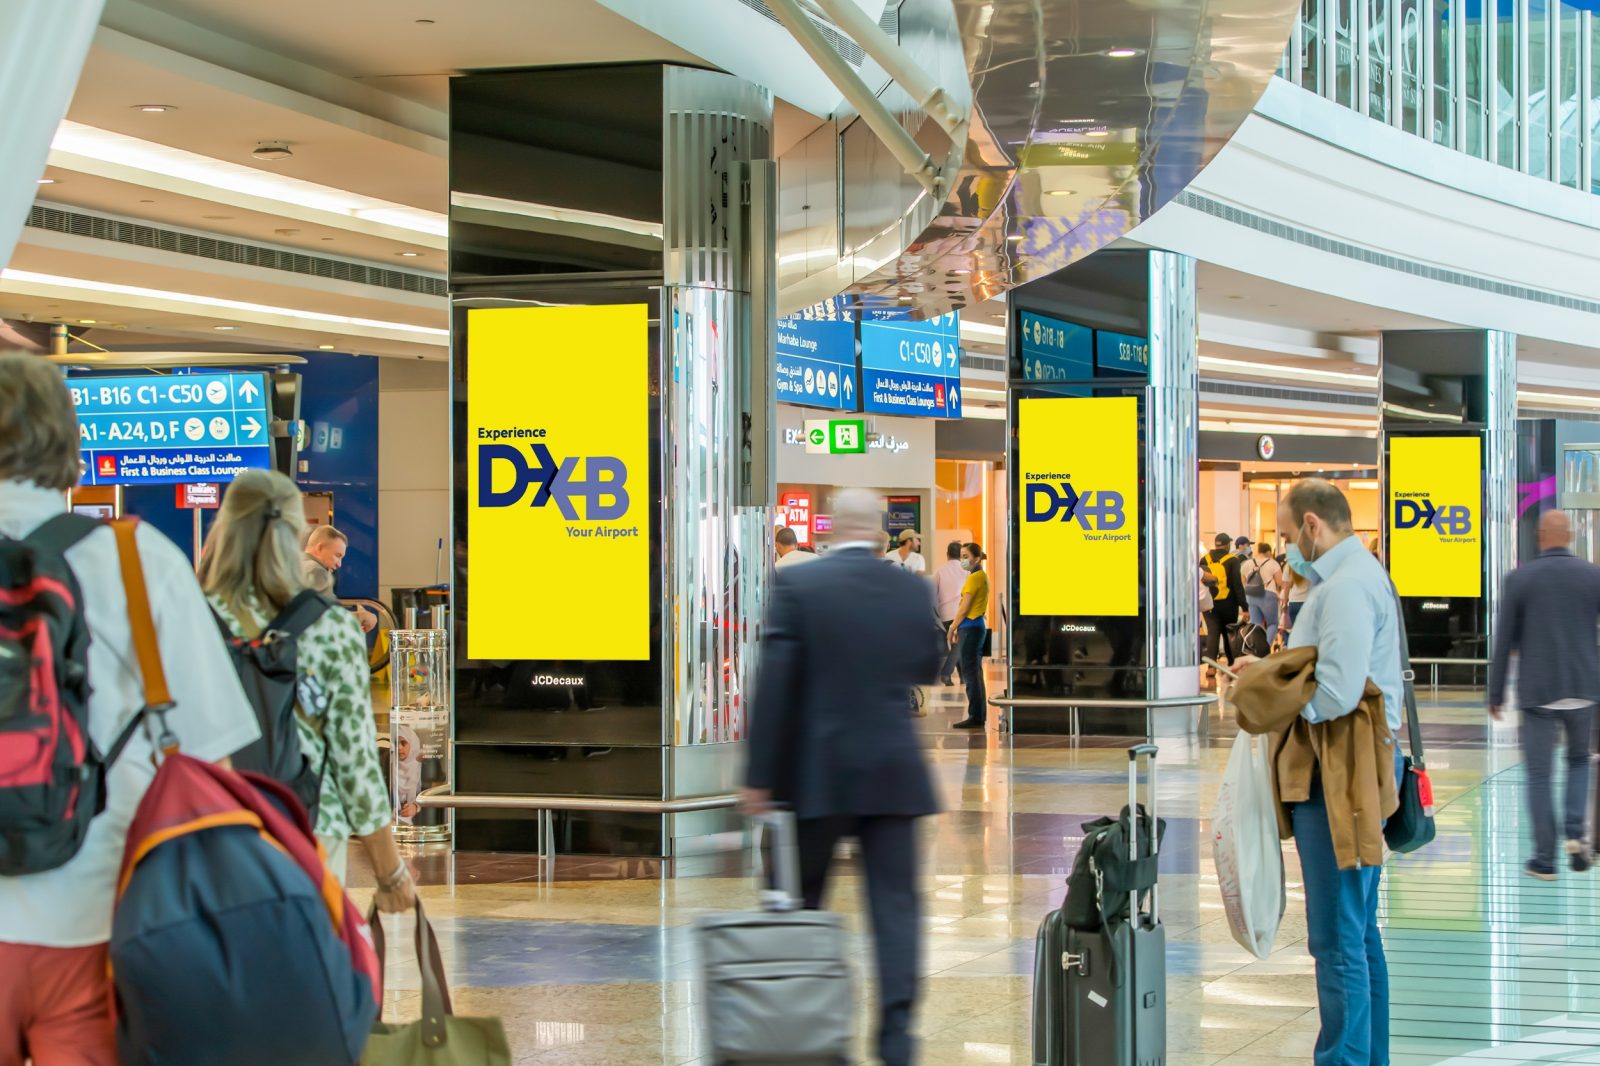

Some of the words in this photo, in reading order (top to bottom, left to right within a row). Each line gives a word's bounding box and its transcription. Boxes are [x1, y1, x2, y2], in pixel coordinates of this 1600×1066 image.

[777, 332, 799, 347] Marhaba
[799, 337, 818, 352] Lounge
[794, 380, 803, 396] Spa
[873, 391, 883, 403] First
[888, 393, 906, 406] Business
[906, 394, 917, 406] Class
[917, 396, 935, 410] Lounges
[478, 427, 547, 441] Experience
[121, 467, 140, 477] First
[142, 467, 149, 476] &
[151, 466, 187, 477] Business
[188, 466, 210, 476] Class
[211, 465, 249, 477] Lounges
[1025, 472, 1071, 481] Experience
[478, 443, 630, 521] DXB
[1026, 483, 1126, 531] DXB
[789, 508, 808, 522] ATM
[1395, 499, 1472, 535] DXB
[566, 526, 593, 537] Your
[595, 526, 638, 540] Airport
[1083, 533, 1102, 541] Your
[1102, 533, 1131, 543] Airport
[1060, 624, 1096, 632] JCDecaux
[532, 675, 584, 686] JCDecaux
